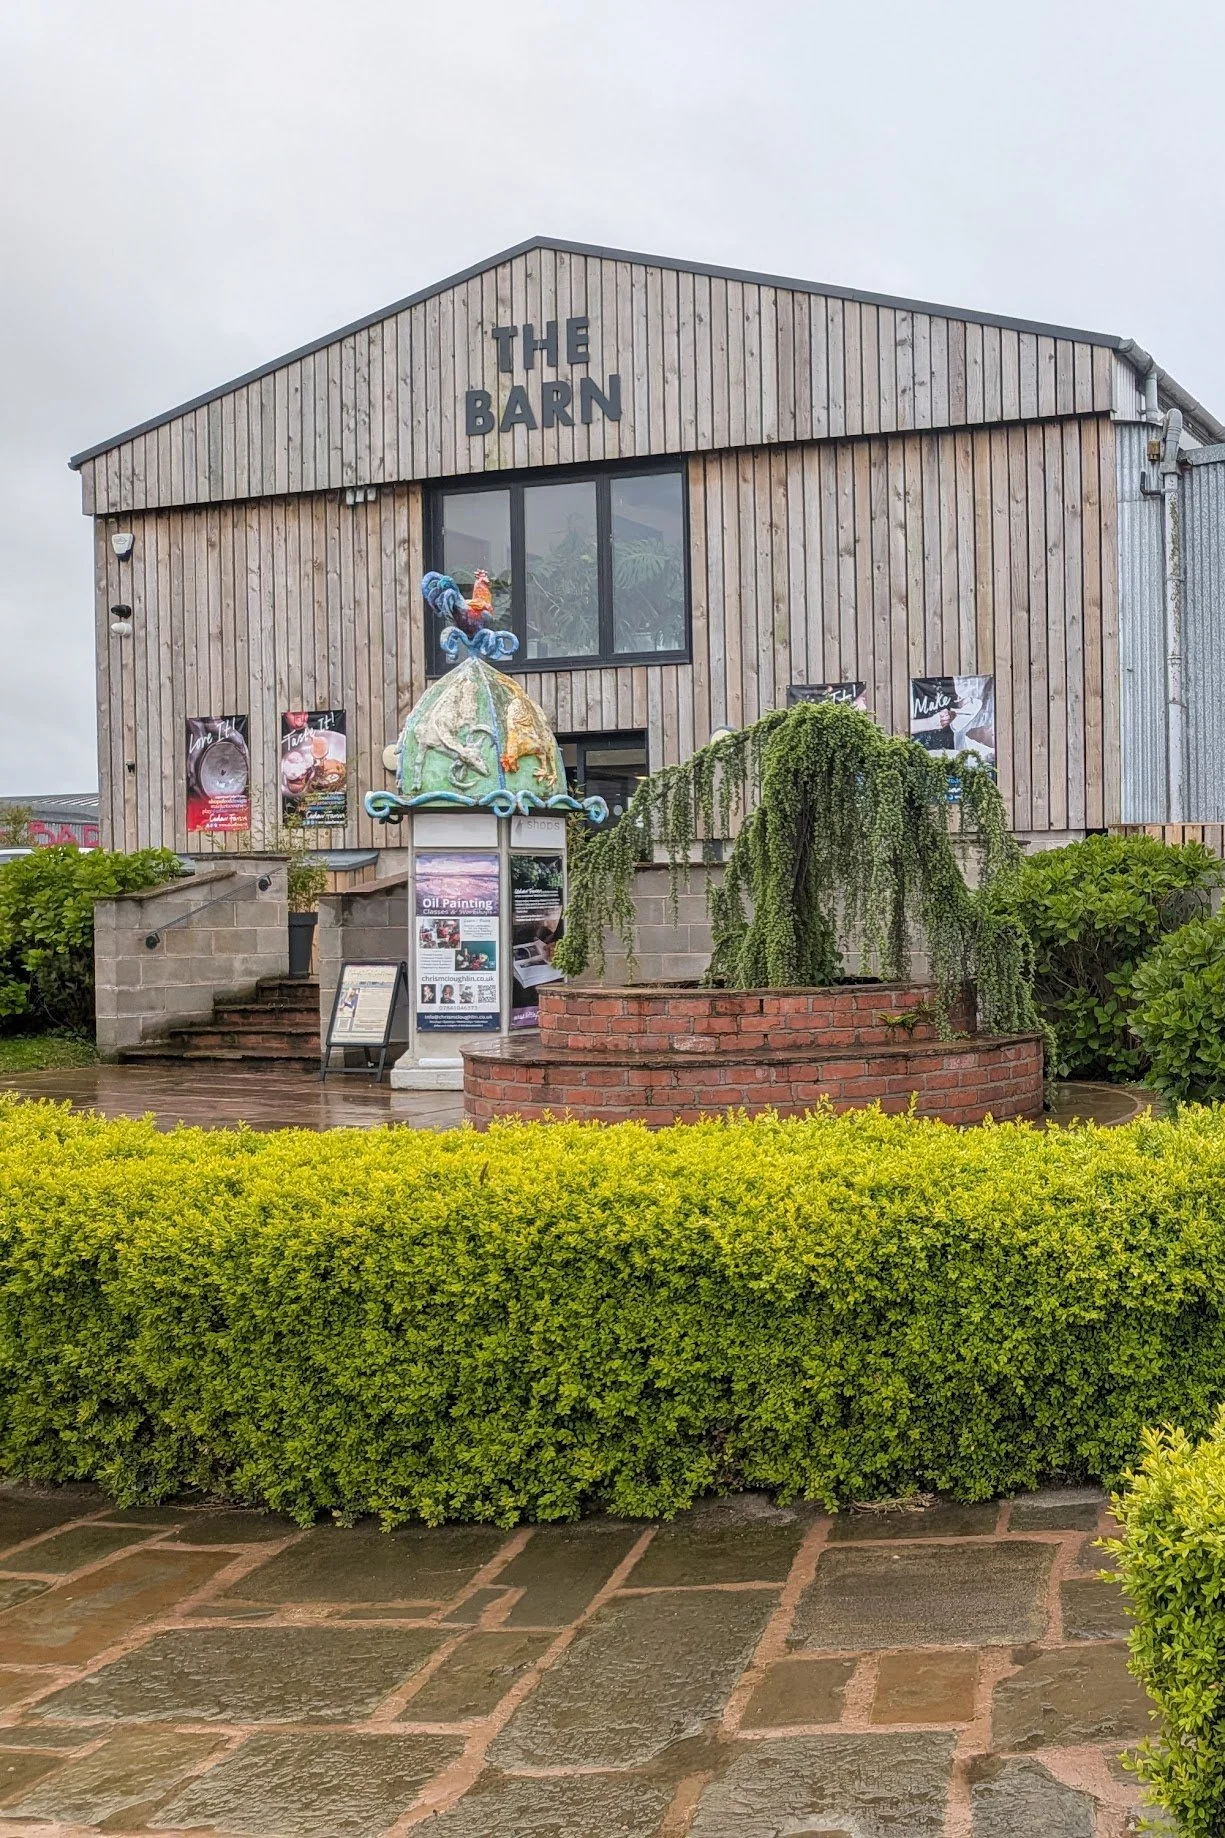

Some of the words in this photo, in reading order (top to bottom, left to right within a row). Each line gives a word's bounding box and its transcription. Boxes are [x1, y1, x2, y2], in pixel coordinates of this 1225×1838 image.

[492, 316, 590, 373] THE
[465, 374, 622, 436] BARN
[189, 732, 213, 753] Love
[216, 717, 236, 742] It!
[281, 729, 316, 751] Taste
[318, 712, 335, 733] It!
[527, 819, 560, 831] shops
[422, 898, 439, 909] Oil
[442, 898, 493, 911] Painting
